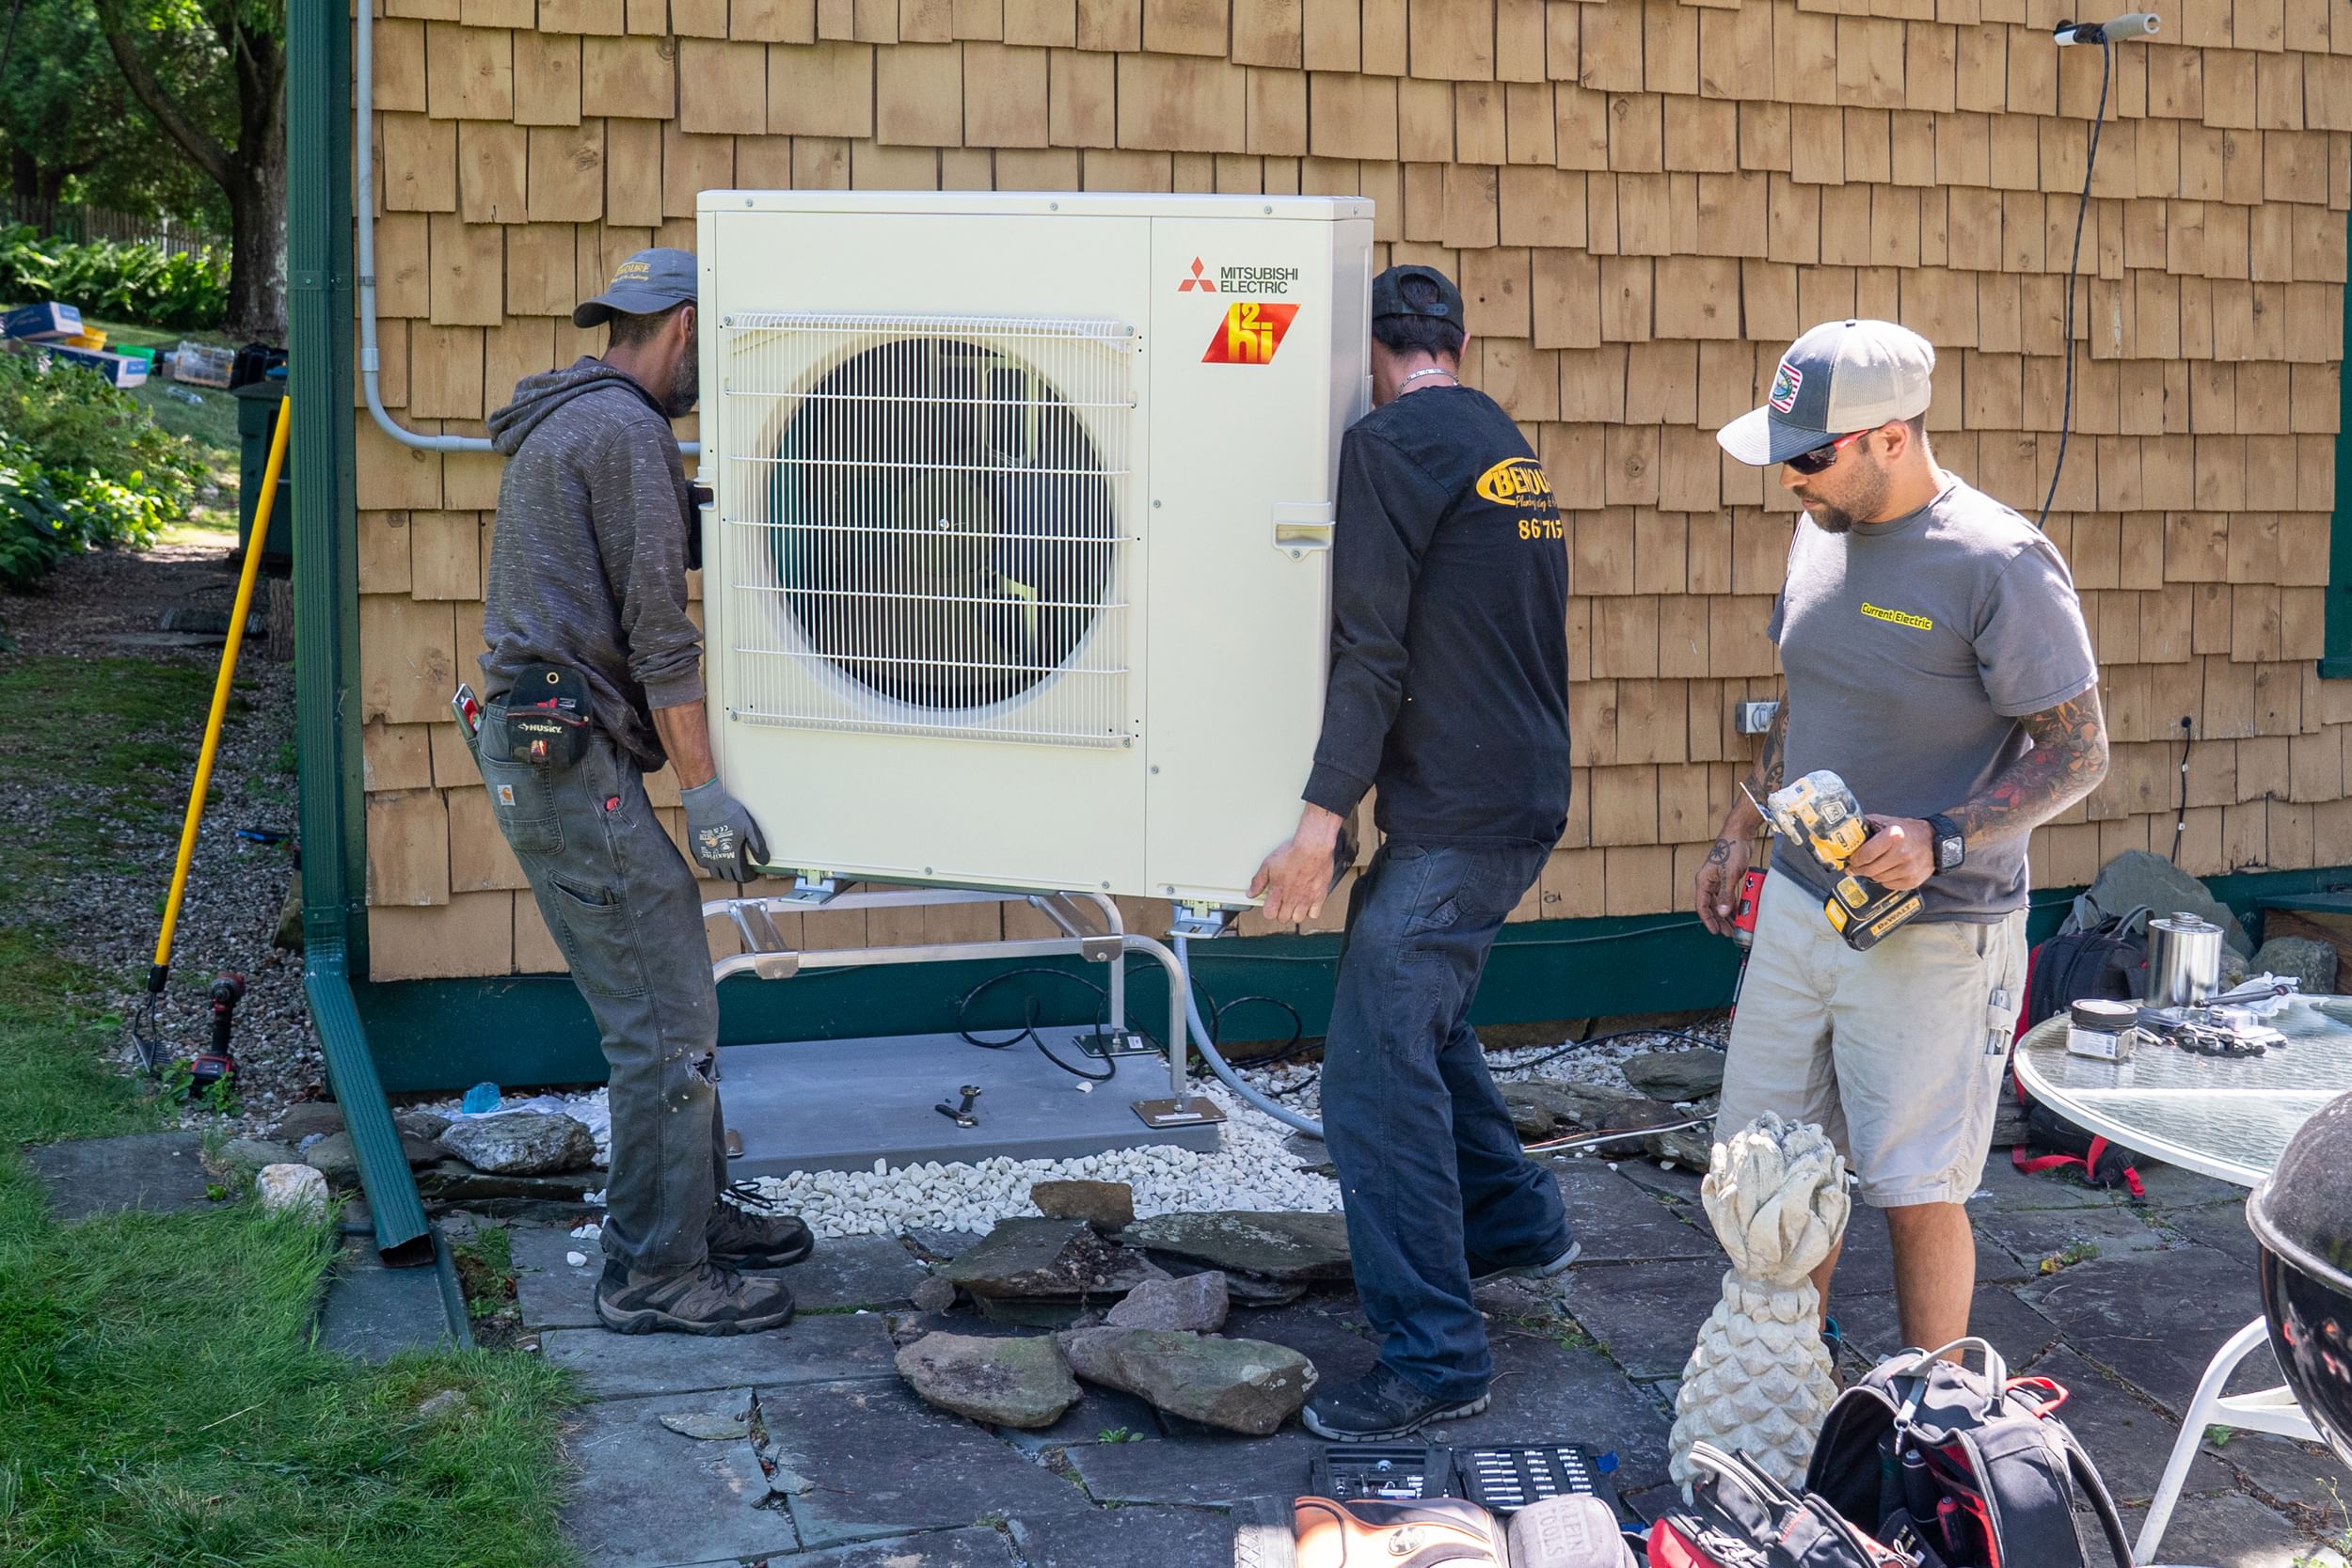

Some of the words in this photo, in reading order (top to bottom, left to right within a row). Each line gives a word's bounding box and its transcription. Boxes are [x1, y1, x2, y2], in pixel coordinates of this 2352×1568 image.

[1220, 267, 1298, 280] MITSUBISHI
[1220, 280, 1288, 293] ELECTRIC
[1863, 604, 1893, 620] Current
[1895, 612, 1931, 628] Electric
[530, 723, 563, 734] HUSKY
